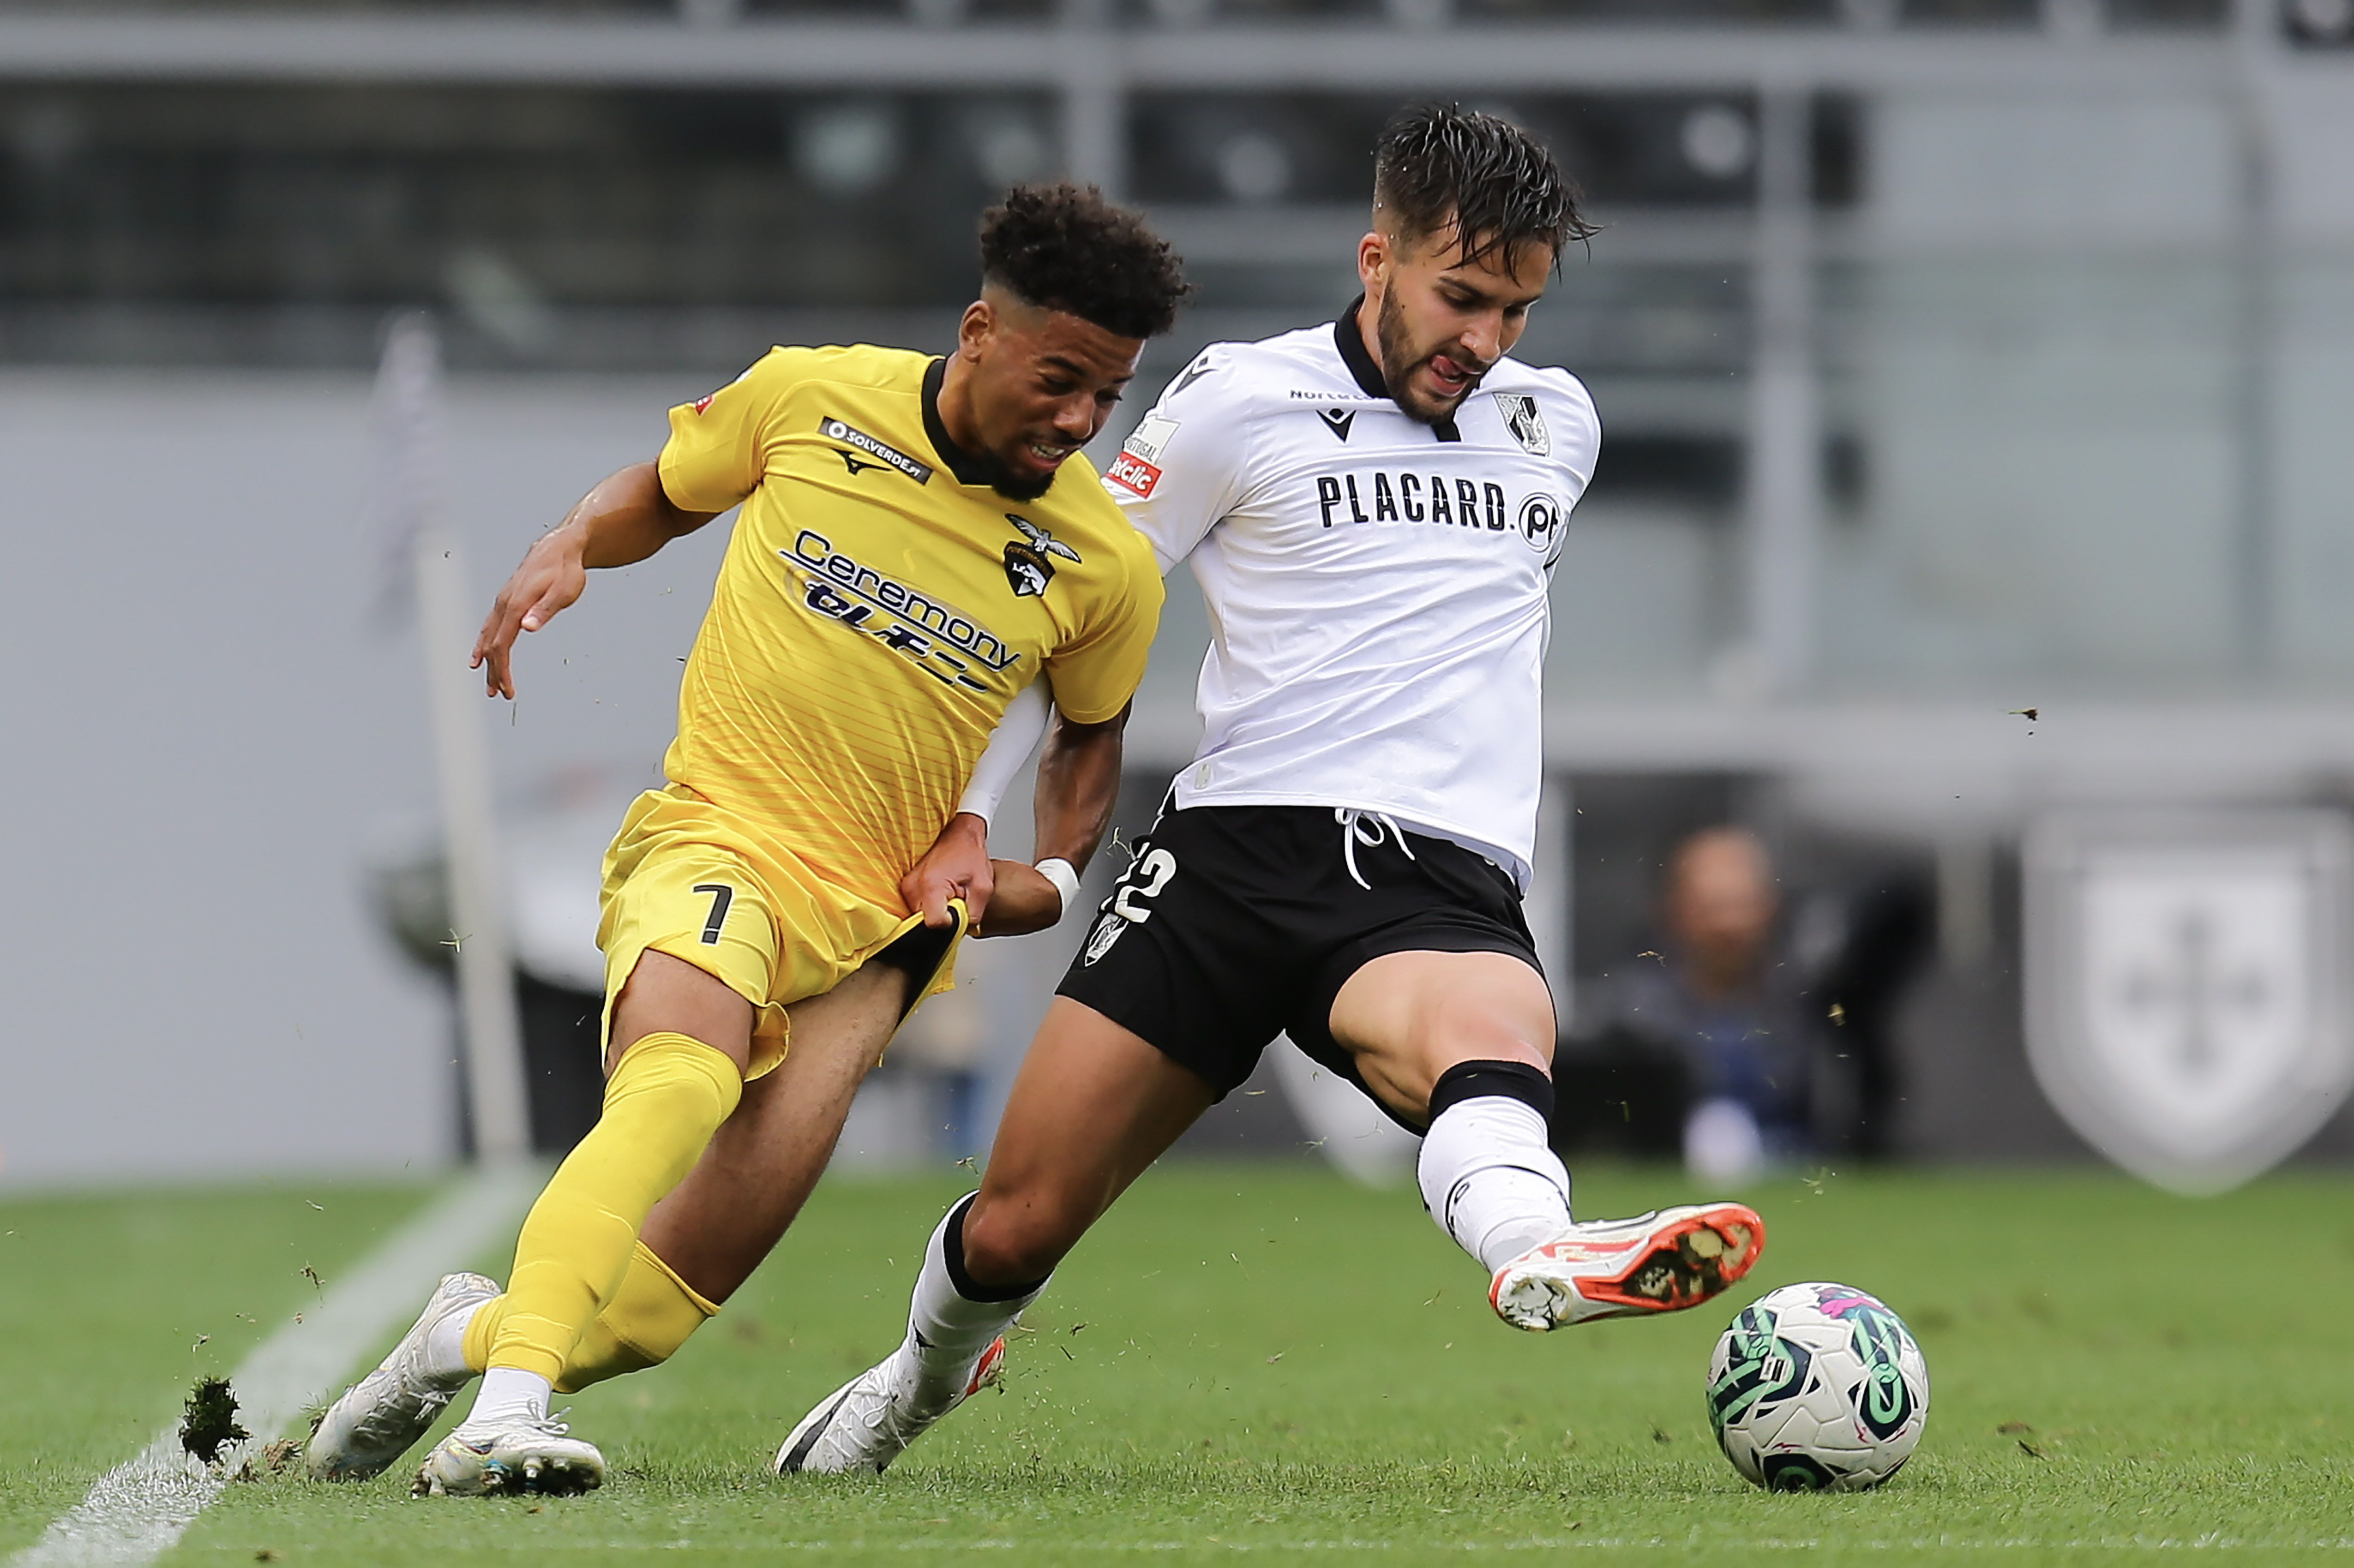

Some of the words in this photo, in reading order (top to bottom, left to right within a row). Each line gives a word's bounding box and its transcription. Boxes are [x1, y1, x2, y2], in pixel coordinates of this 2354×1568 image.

[795, 530, 1021, 667] Ceremony
[693, 884, 733, 944] 7
[1100, 840, 1177, 923] 2
